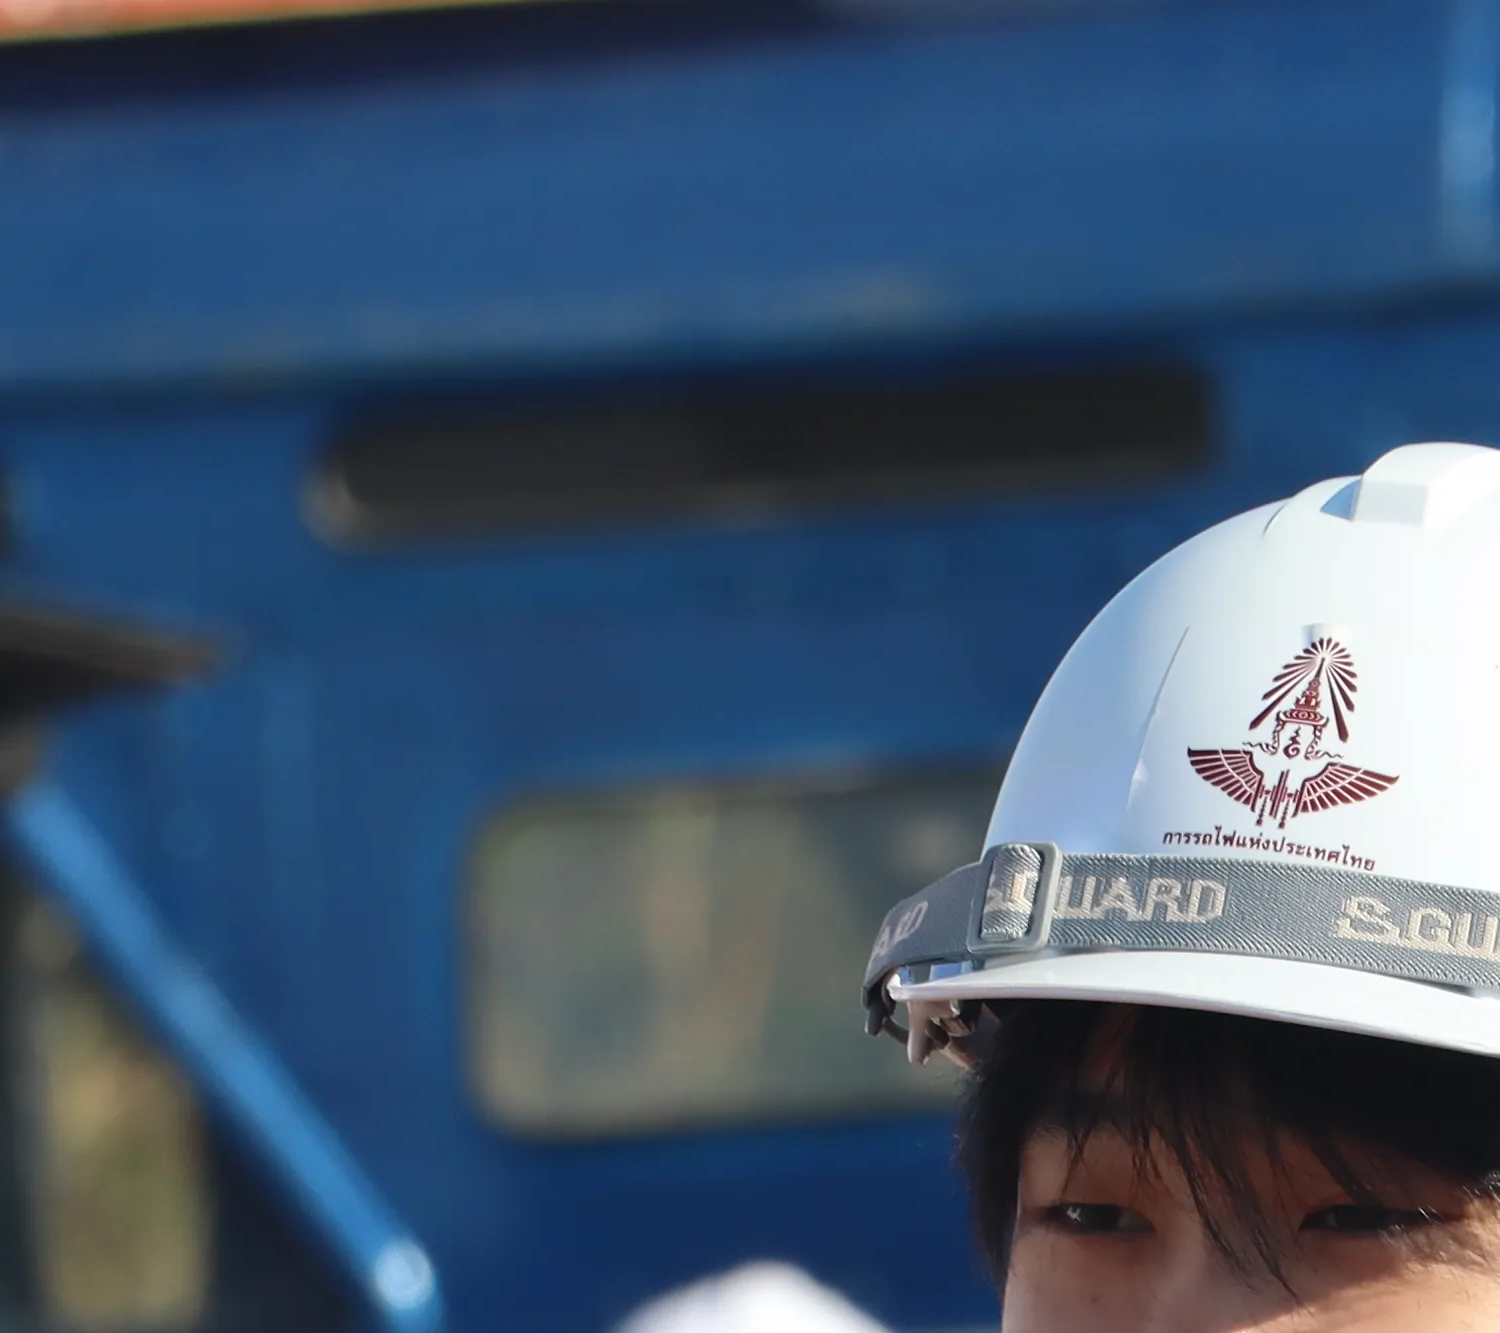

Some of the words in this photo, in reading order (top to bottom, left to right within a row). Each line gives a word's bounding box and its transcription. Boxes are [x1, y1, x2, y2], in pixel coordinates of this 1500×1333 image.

[1162, 825, 1376, 871] การรถไฟแห่งประเทศไทย
